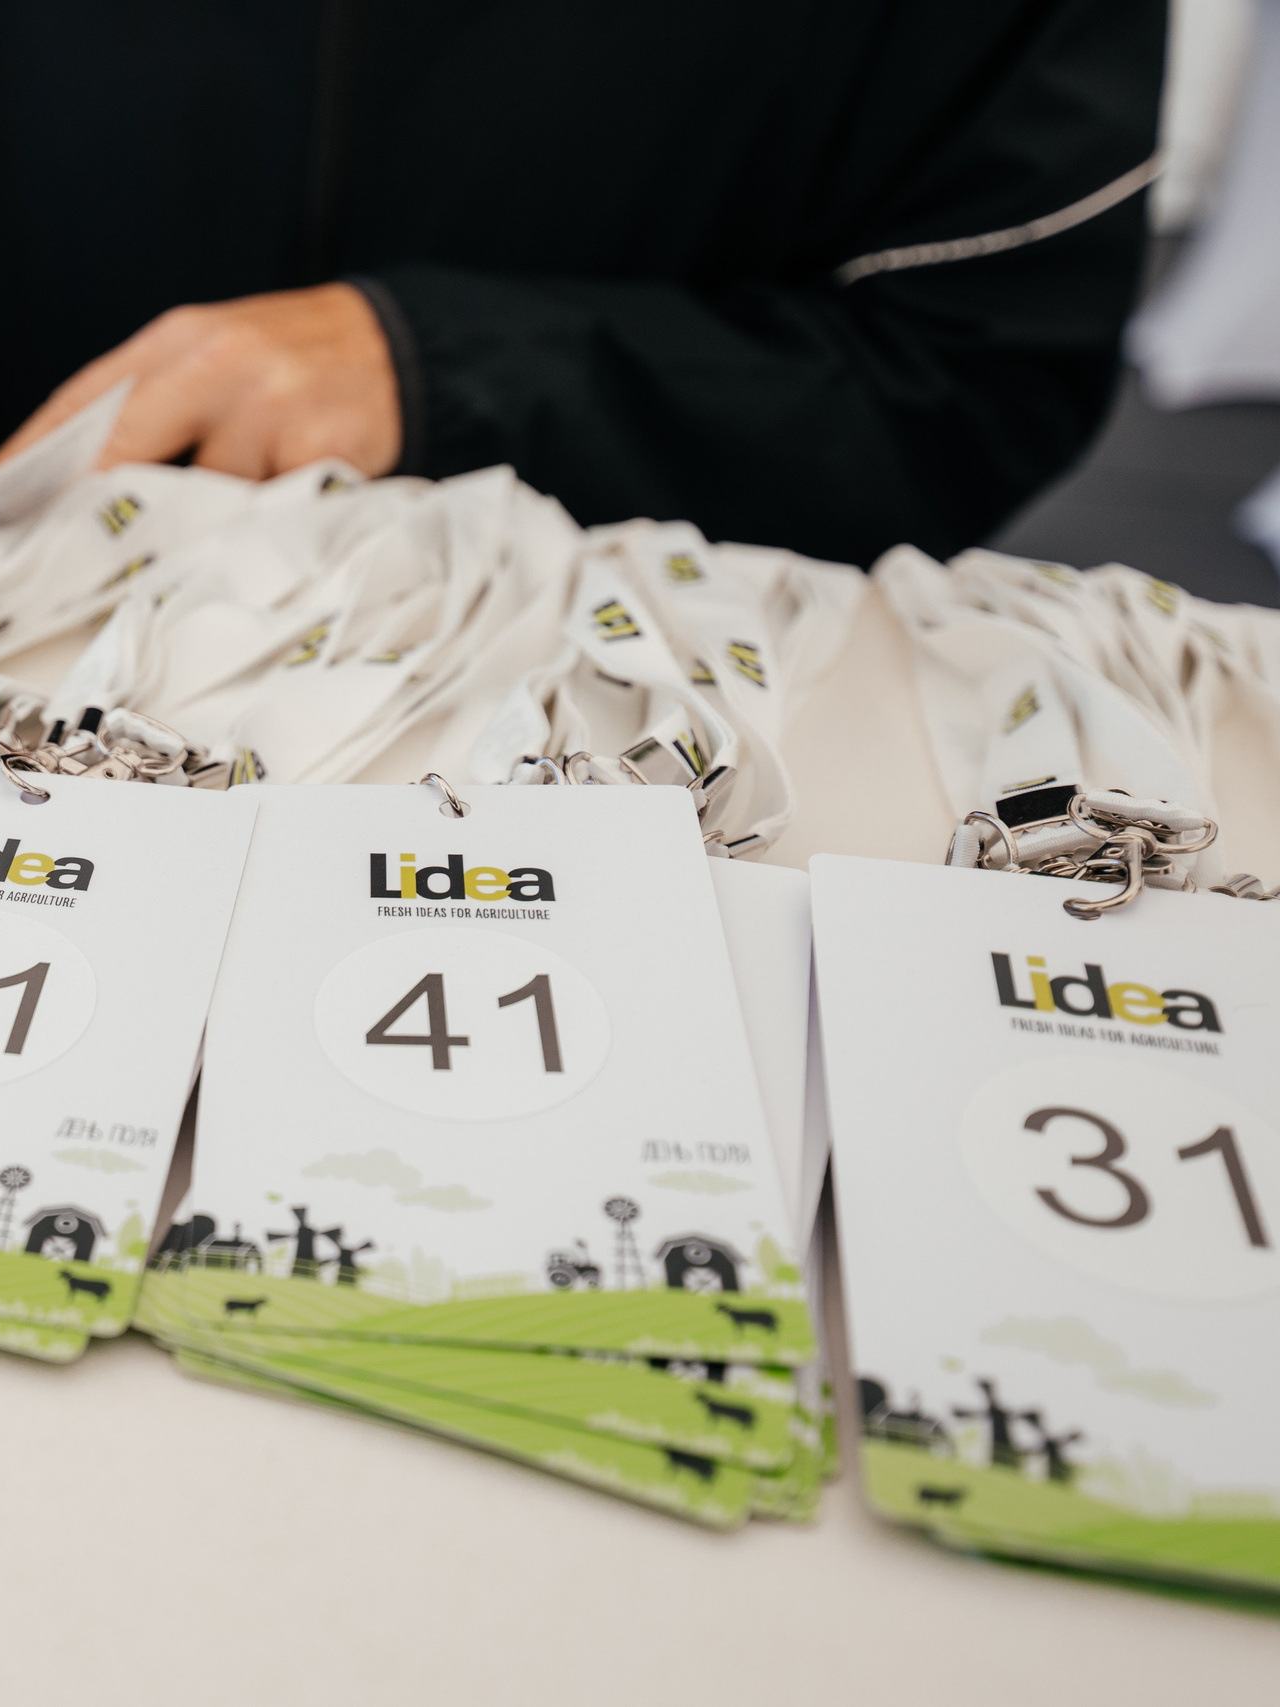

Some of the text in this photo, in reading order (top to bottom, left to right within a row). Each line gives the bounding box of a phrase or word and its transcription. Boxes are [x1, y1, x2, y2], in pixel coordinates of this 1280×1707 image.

[6, 891, 77, 908] AGRICULTURE
[370, 853, 557, 902] Lidea
[377, 906, 551, 921] FRESH IDEAS FOR AGRICULTURE
[991, 951, 1225, 1034] Lidea
[365, 972, 566, 1075] 41
[1010, 1016, 1220, 1056] FRESH IDEAS FOR AGRICULTURE
[1023, 1106, 1272, 1250] 31
